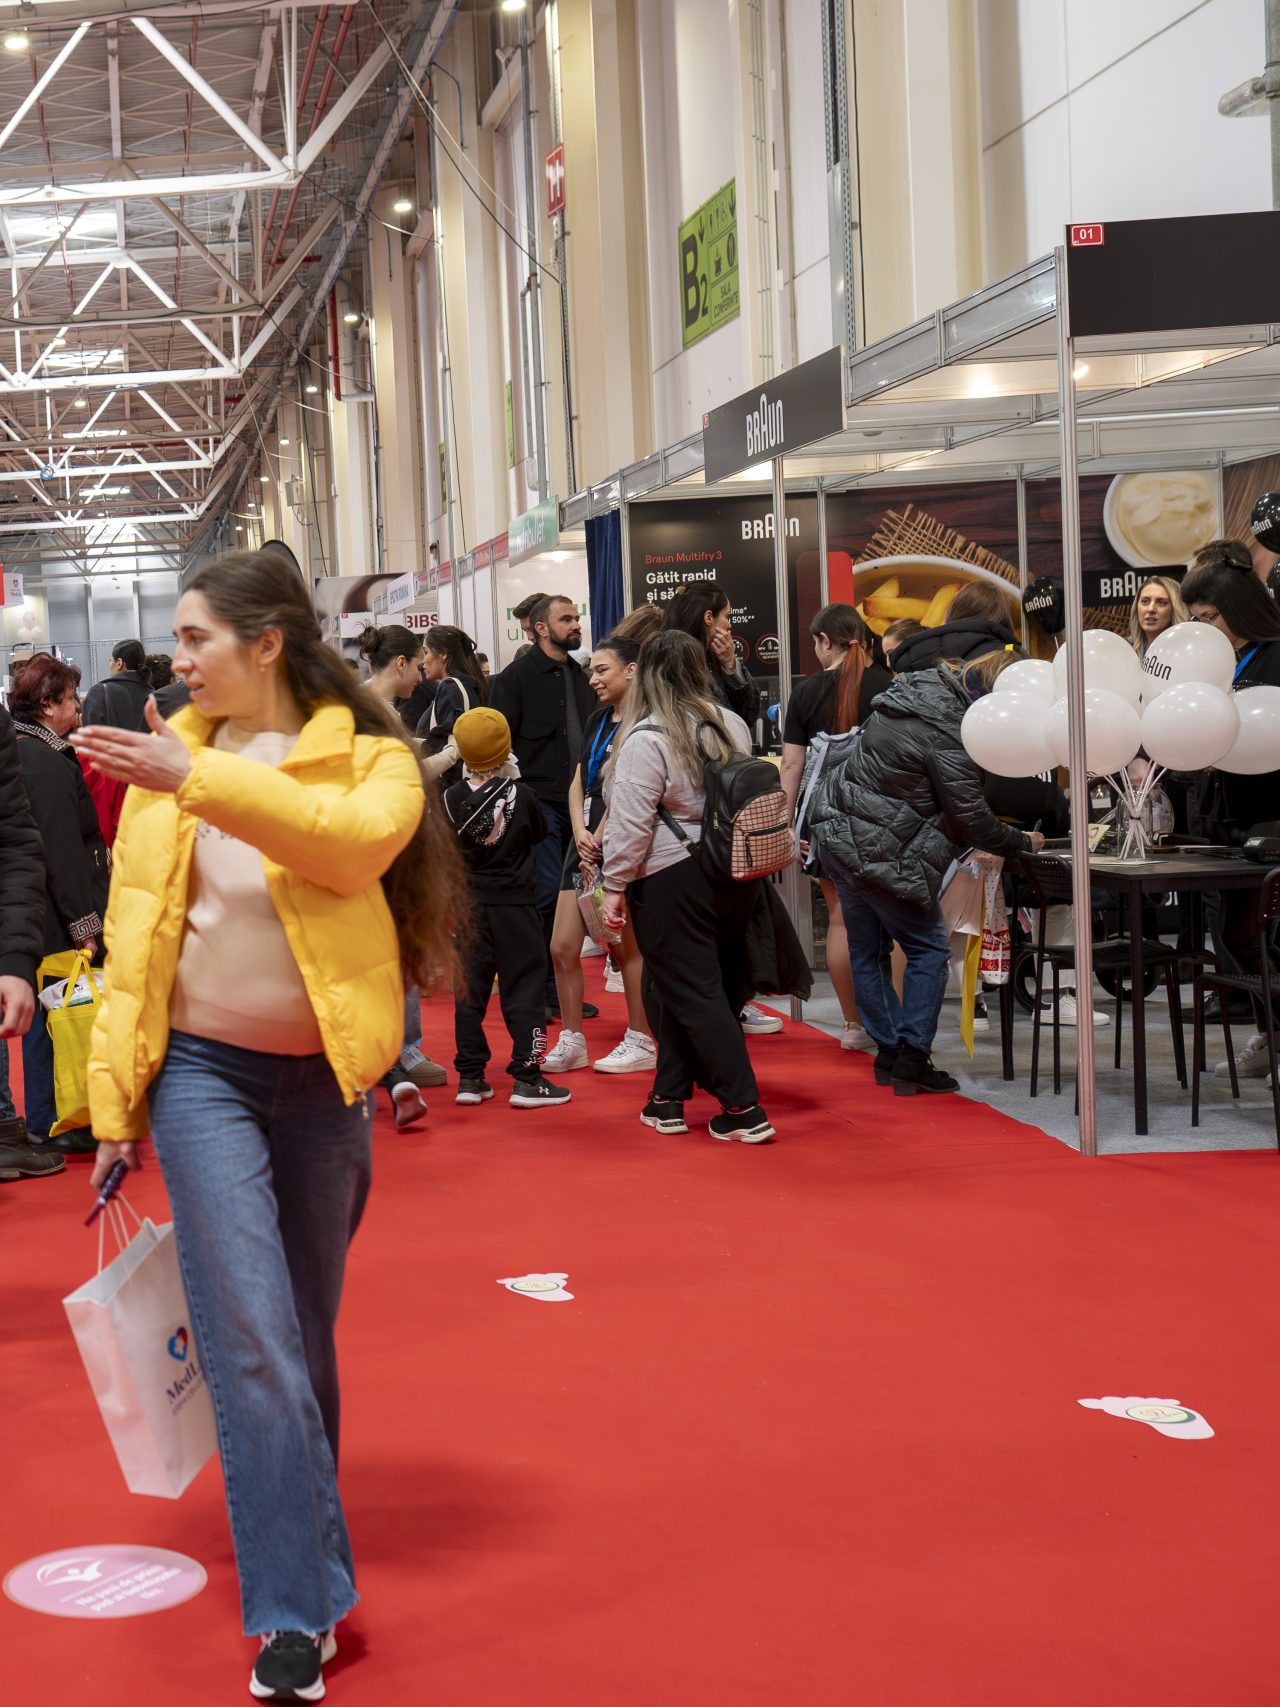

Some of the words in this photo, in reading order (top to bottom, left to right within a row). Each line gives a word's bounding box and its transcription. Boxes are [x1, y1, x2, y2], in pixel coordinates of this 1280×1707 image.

[1080, 228, 1093, 240] 01
[746, 393, 785, 457] BRAUN
[645, 554, 674, 564] Braun
[676, 551, 715, 562] Multifry
[716, 550, 722, 560] 3
[646, 571, 680, 584] Gătit
[682, 568, 716, 583] rapid
